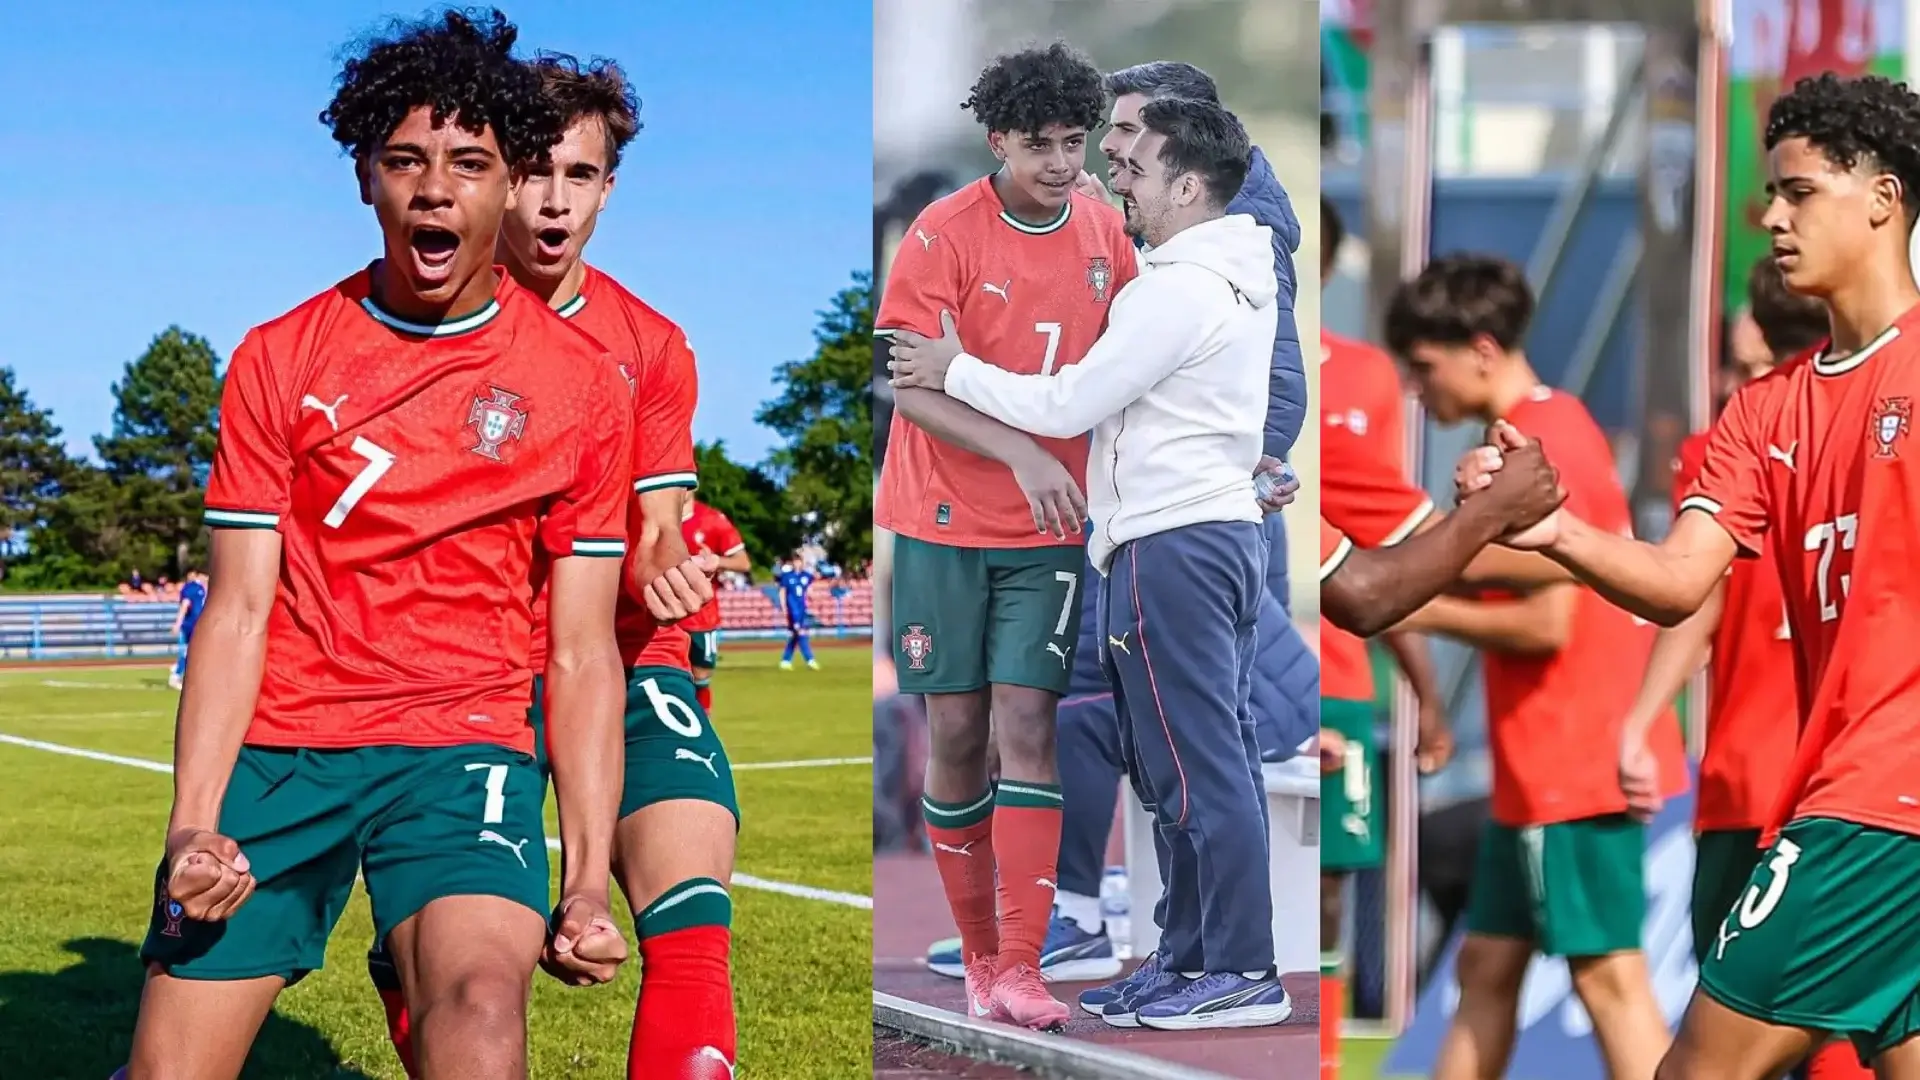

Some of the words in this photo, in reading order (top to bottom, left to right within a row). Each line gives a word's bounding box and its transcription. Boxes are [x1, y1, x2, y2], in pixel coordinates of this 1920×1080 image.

[1034, 322, 1063, 377] 7
[322, 434, 397, 530] 7
[1054, 570, 1078, 637] 7
[636, 677, 702, 738] 6
[463, 762, 509, 824] 7
